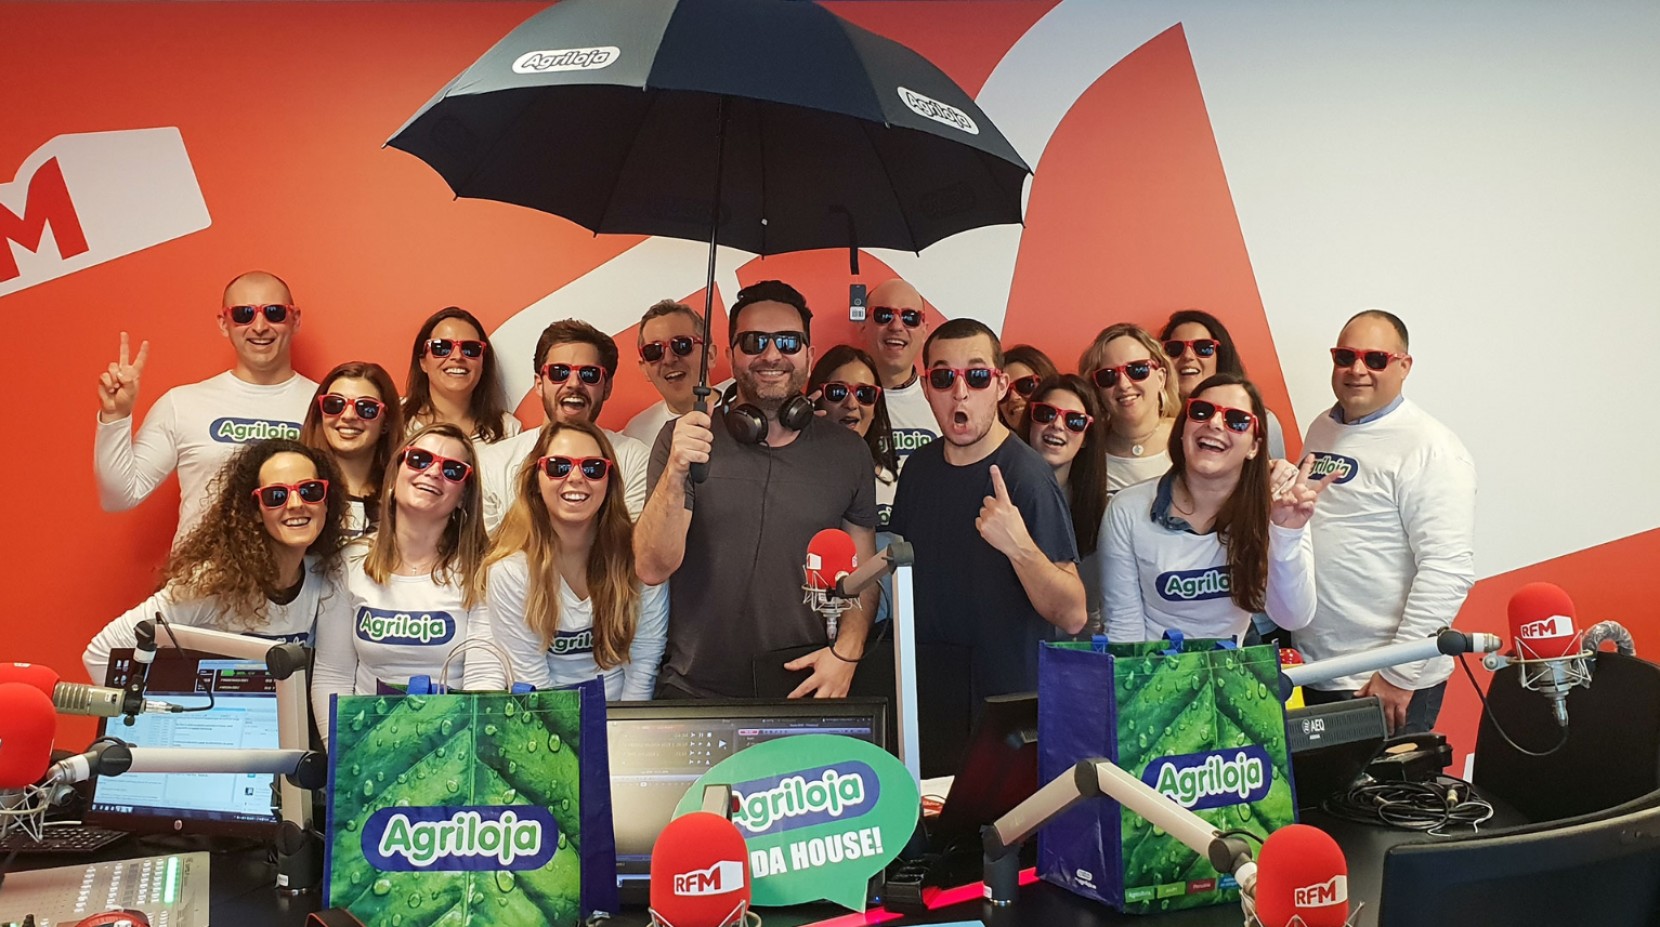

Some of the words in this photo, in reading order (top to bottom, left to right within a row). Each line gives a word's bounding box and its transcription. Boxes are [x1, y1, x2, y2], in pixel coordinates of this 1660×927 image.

[521, 49, 611, 71] Agriloja
[905, 91, 972, 129] Agriloja
[219, 421, 300, 440] Agriloja
[360, 611, 445, 641] Agriloja
[1521, 618, 1557, 637] RFM
[551, 630, 595, 653] gril
[1310, 718, 1325, 732] AEQ
[1157, 754, 1262, 804] Agriloja
[383, 815, 538, 862] Agriloja
[750, 847, 787, 879] DA
[789, 826, 884, 872] HOUSE!
[676, 866, 721, 893] RFM
[1296, 879, 1336, 905] RFM
